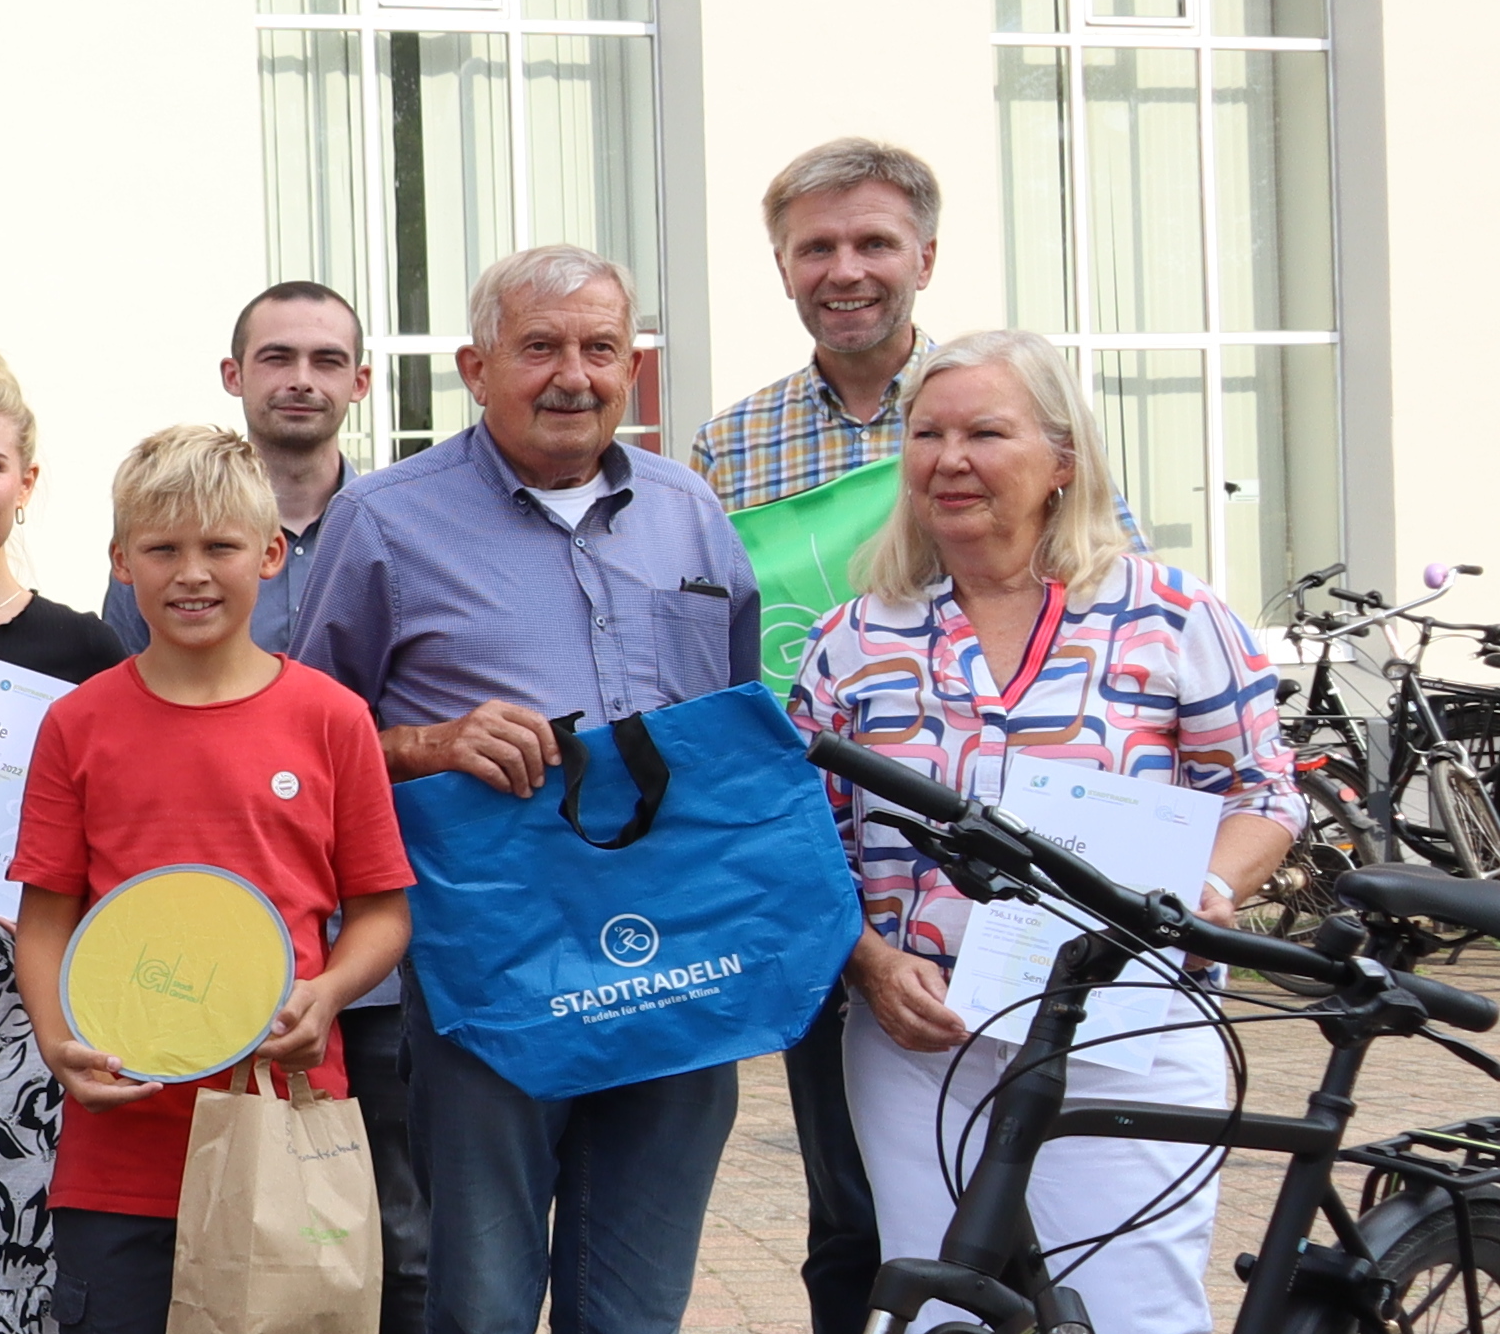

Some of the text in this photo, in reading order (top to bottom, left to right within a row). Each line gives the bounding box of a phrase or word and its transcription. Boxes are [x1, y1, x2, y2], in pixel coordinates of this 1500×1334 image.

[1, 763, 23, 776] 2022
[550, 953, 742, 1017] STADTRADELN
[582, 985, 721, 1025] Radeln für ein gutes Klima
